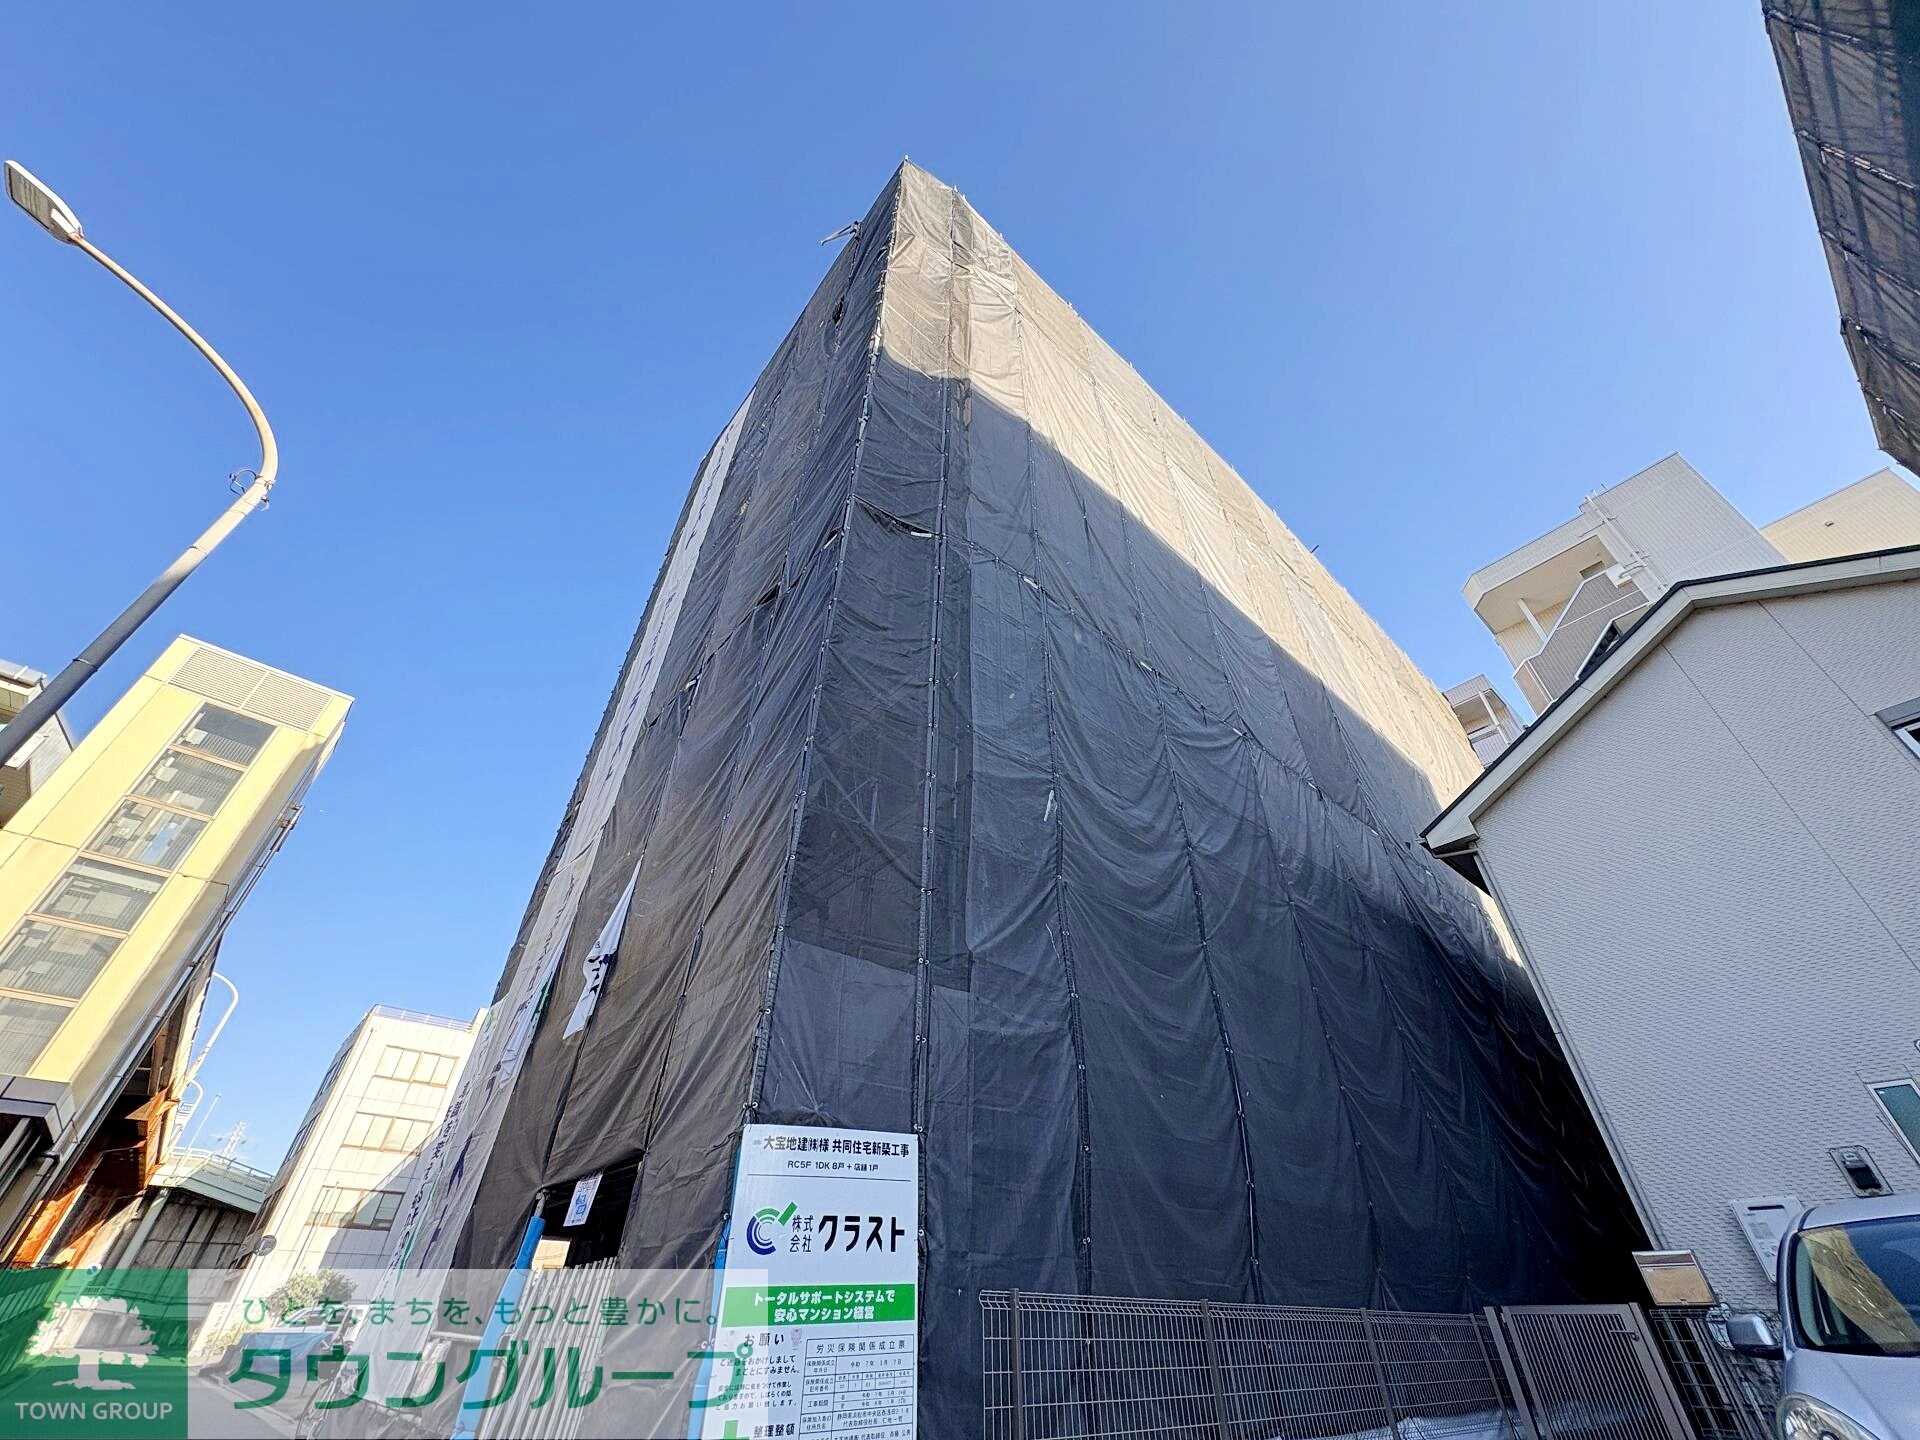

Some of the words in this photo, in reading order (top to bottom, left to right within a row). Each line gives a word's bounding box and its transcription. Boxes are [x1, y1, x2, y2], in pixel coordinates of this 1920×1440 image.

[832, 1139, 909, 1157] 共同住宅新築工事
[787, 1160, 812, 1169] RC5F
[815, 1161, 830, 1170] 1DK
[832, 1161, 845, 1170] 8戸
[792, 1215, 814, 1232] 株式
[818, 1215, 905, 1252] クラスト
[789, 1234, 813, 1253] 会社
[754, 1290, 895, 1306] トータルサポートシステムで
[774, 1306, 875, 1323] 安心マンション経営
[744, 1333, 784, 1347] お願い
